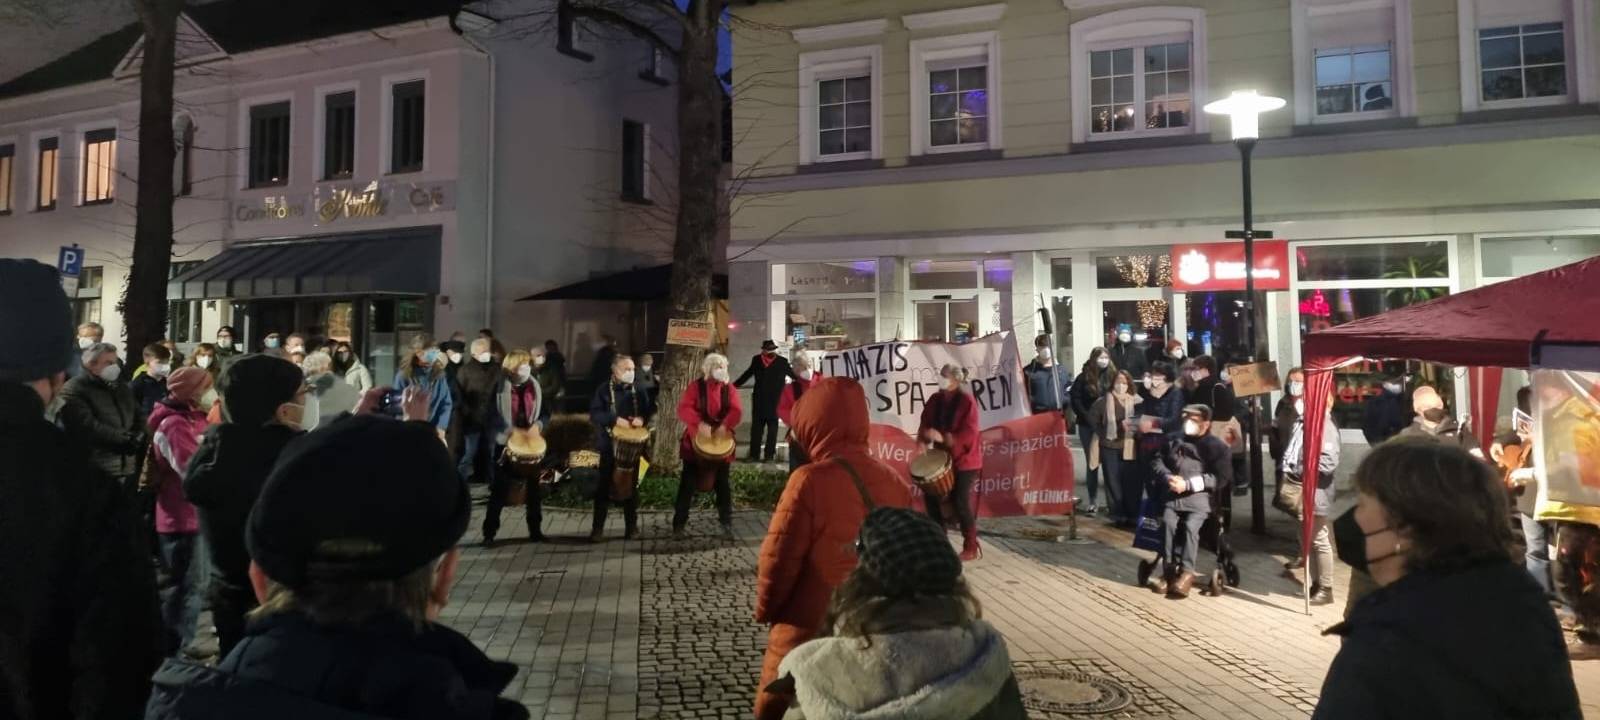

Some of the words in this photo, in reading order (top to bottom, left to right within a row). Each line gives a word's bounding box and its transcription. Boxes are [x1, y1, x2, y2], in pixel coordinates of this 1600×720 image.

[63, 250, 77, 272] P
[842, 343, 909, 381] NAZIS
[878, 441, 914, 463] Wer
[973, 471, 1030, 495] apiert!
